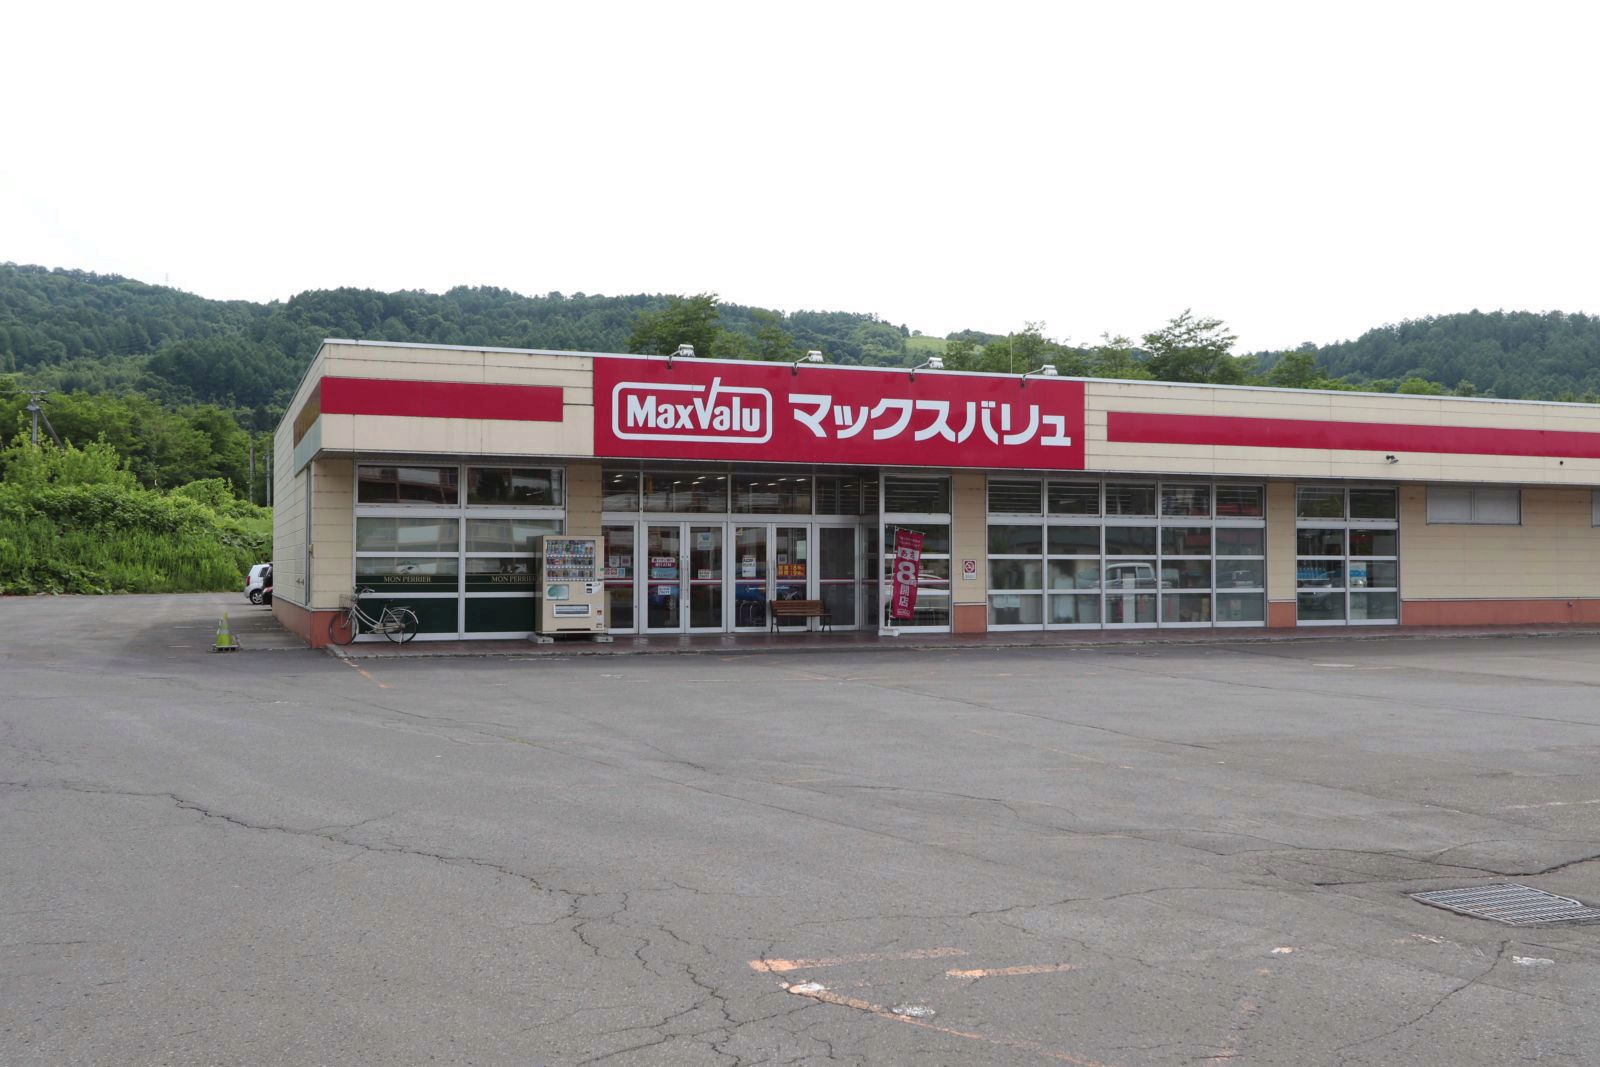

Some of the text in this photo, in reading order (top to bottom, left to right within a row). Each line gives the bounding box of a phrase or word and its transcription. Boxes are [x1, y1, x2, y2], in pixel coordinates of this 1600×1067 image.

[627, 377, 760, 432] MaxValu
[788, 393, 1072, 447] マックスバリュ
[383, 575, 401, 583] MON
[491, 575, 508, 583] MON
